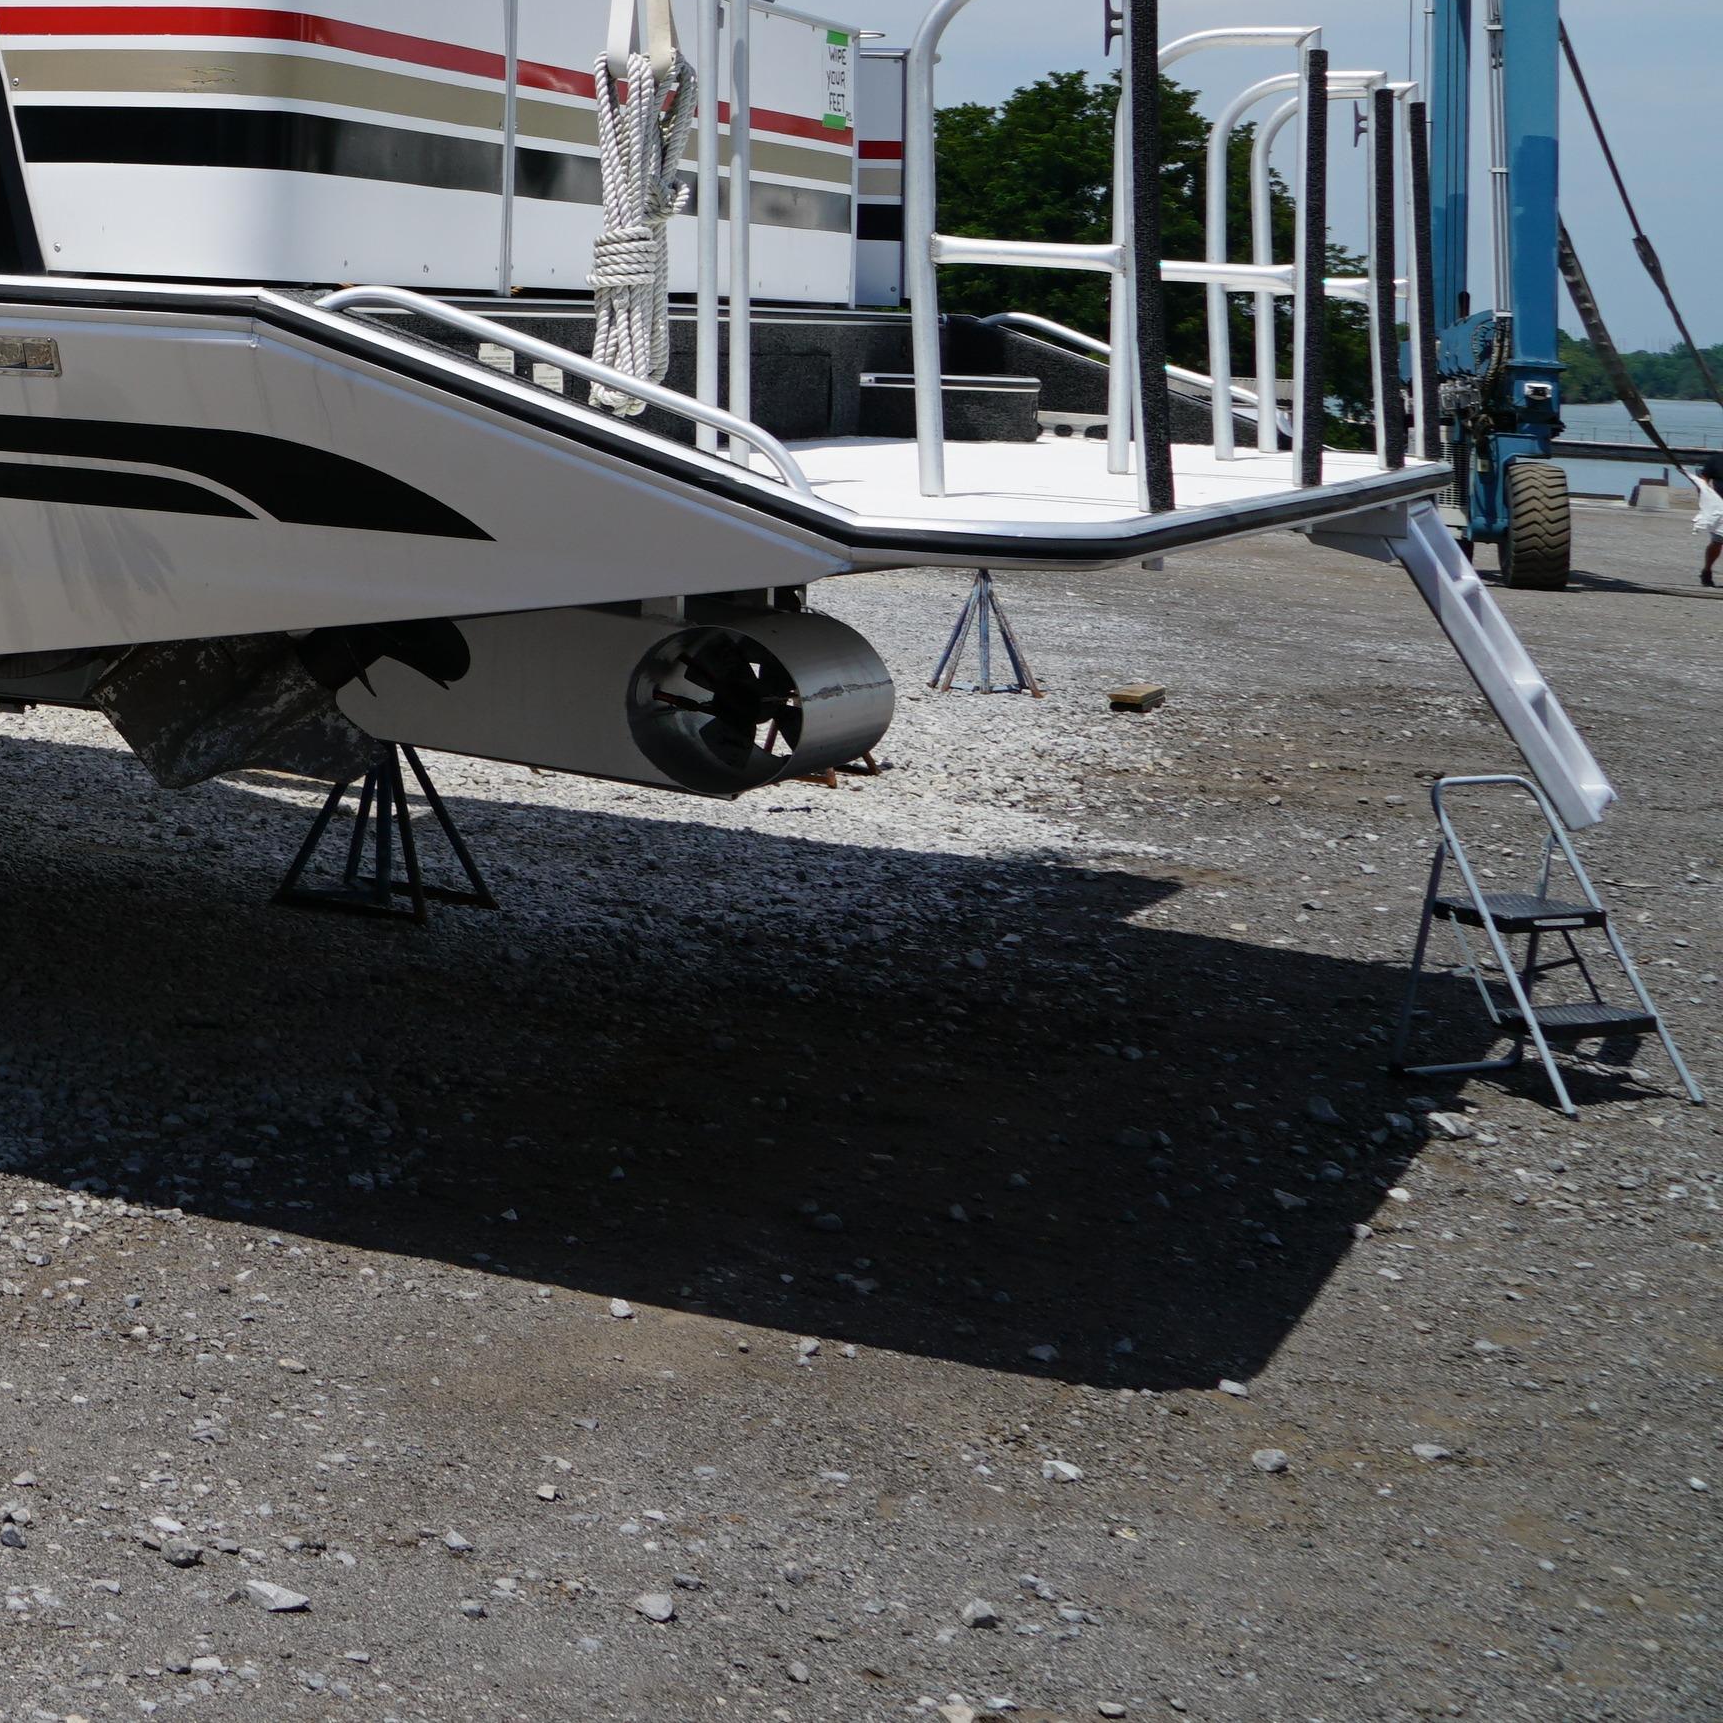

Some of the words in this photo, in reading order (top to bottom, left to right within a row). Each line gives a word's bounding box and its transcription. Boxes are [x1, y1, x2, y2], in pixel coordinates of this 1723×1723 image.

[828, 45, 847, 66] WIPE
[826, 69, 846, 91] YOUR
[828, 91, 845, 113] FEET
